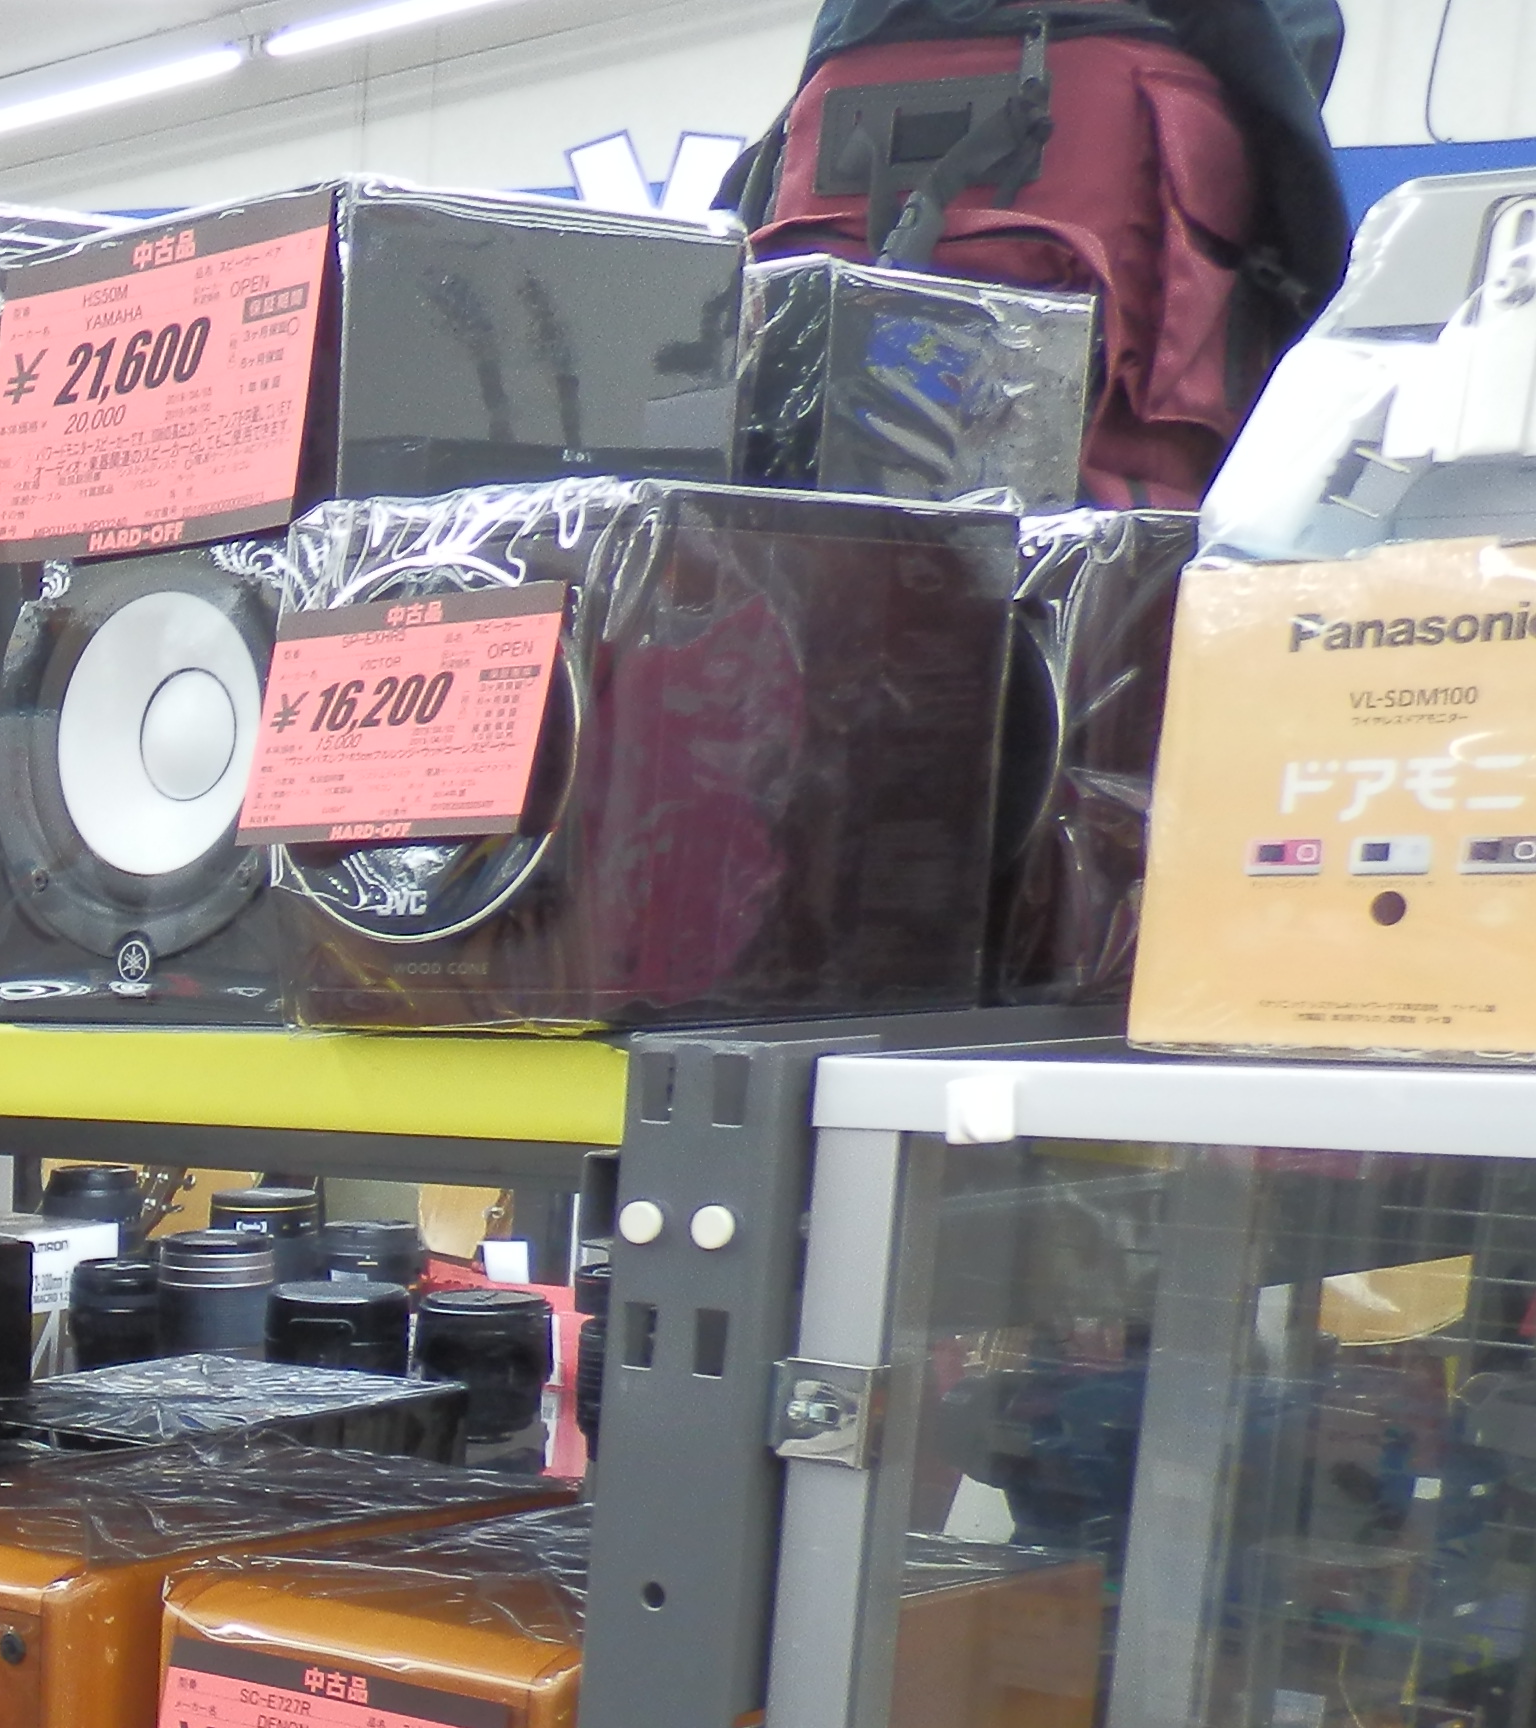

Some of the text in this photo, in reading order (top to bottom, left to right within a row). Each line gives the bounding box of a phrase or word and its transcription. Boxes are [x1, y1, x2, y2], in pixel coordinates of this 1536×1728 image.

[132, 229, 195, 269] 中古品
[82, 283, 128, 308] HS50M
[230, 275, 270, 298] OPEN
[84, 304, 143, 331] YAMAHA
[3, 348, 49, 405] ¥
[53, 316, 211, 407] 21,600
[64, 404, 126, 436] 20,000
[387, 601, 443, 627] 中古品
[1288, 601, 1536, 653] Panasoni
[487, 640, 534, 660] OPEN
[269, 690, 310, 733] ¥
[309, 671, 454, 734] 16,200
[1349, 685, 1479, 710] VL-SDM100
[375, 888, 428, 917] JVC
[303, 1669, 370, 1705] 中古品
[240, 1689, 312, 1715] SC-E727R
